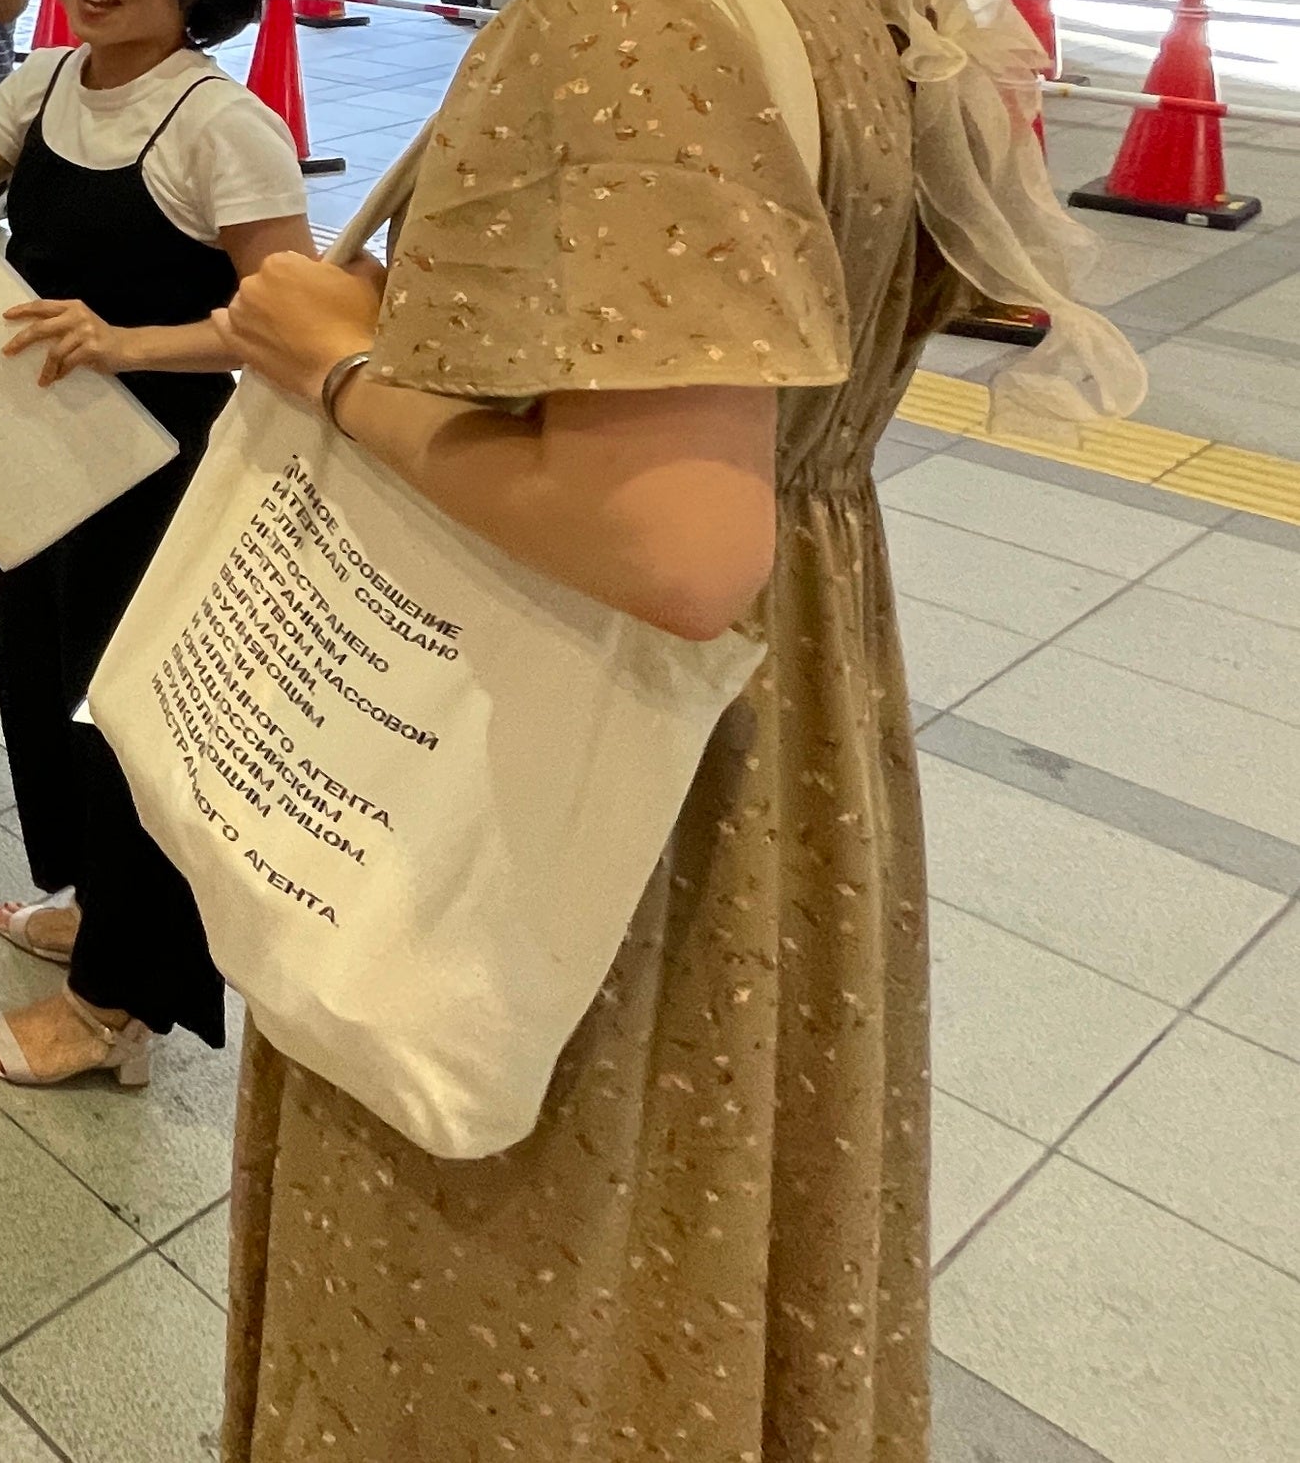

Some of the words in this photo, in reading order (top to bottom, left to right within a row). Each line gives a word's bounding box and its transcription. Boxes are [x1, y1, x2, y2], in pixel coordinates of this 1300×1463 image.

[338, 538, 464, 641] СООБЩЕНИЕ
[354, 586, 460, 662] СОЗДАНО
[314, 656, 440, 751] МАССОВОЙ
[243, 848, 341, 928] АГЕНТА.
